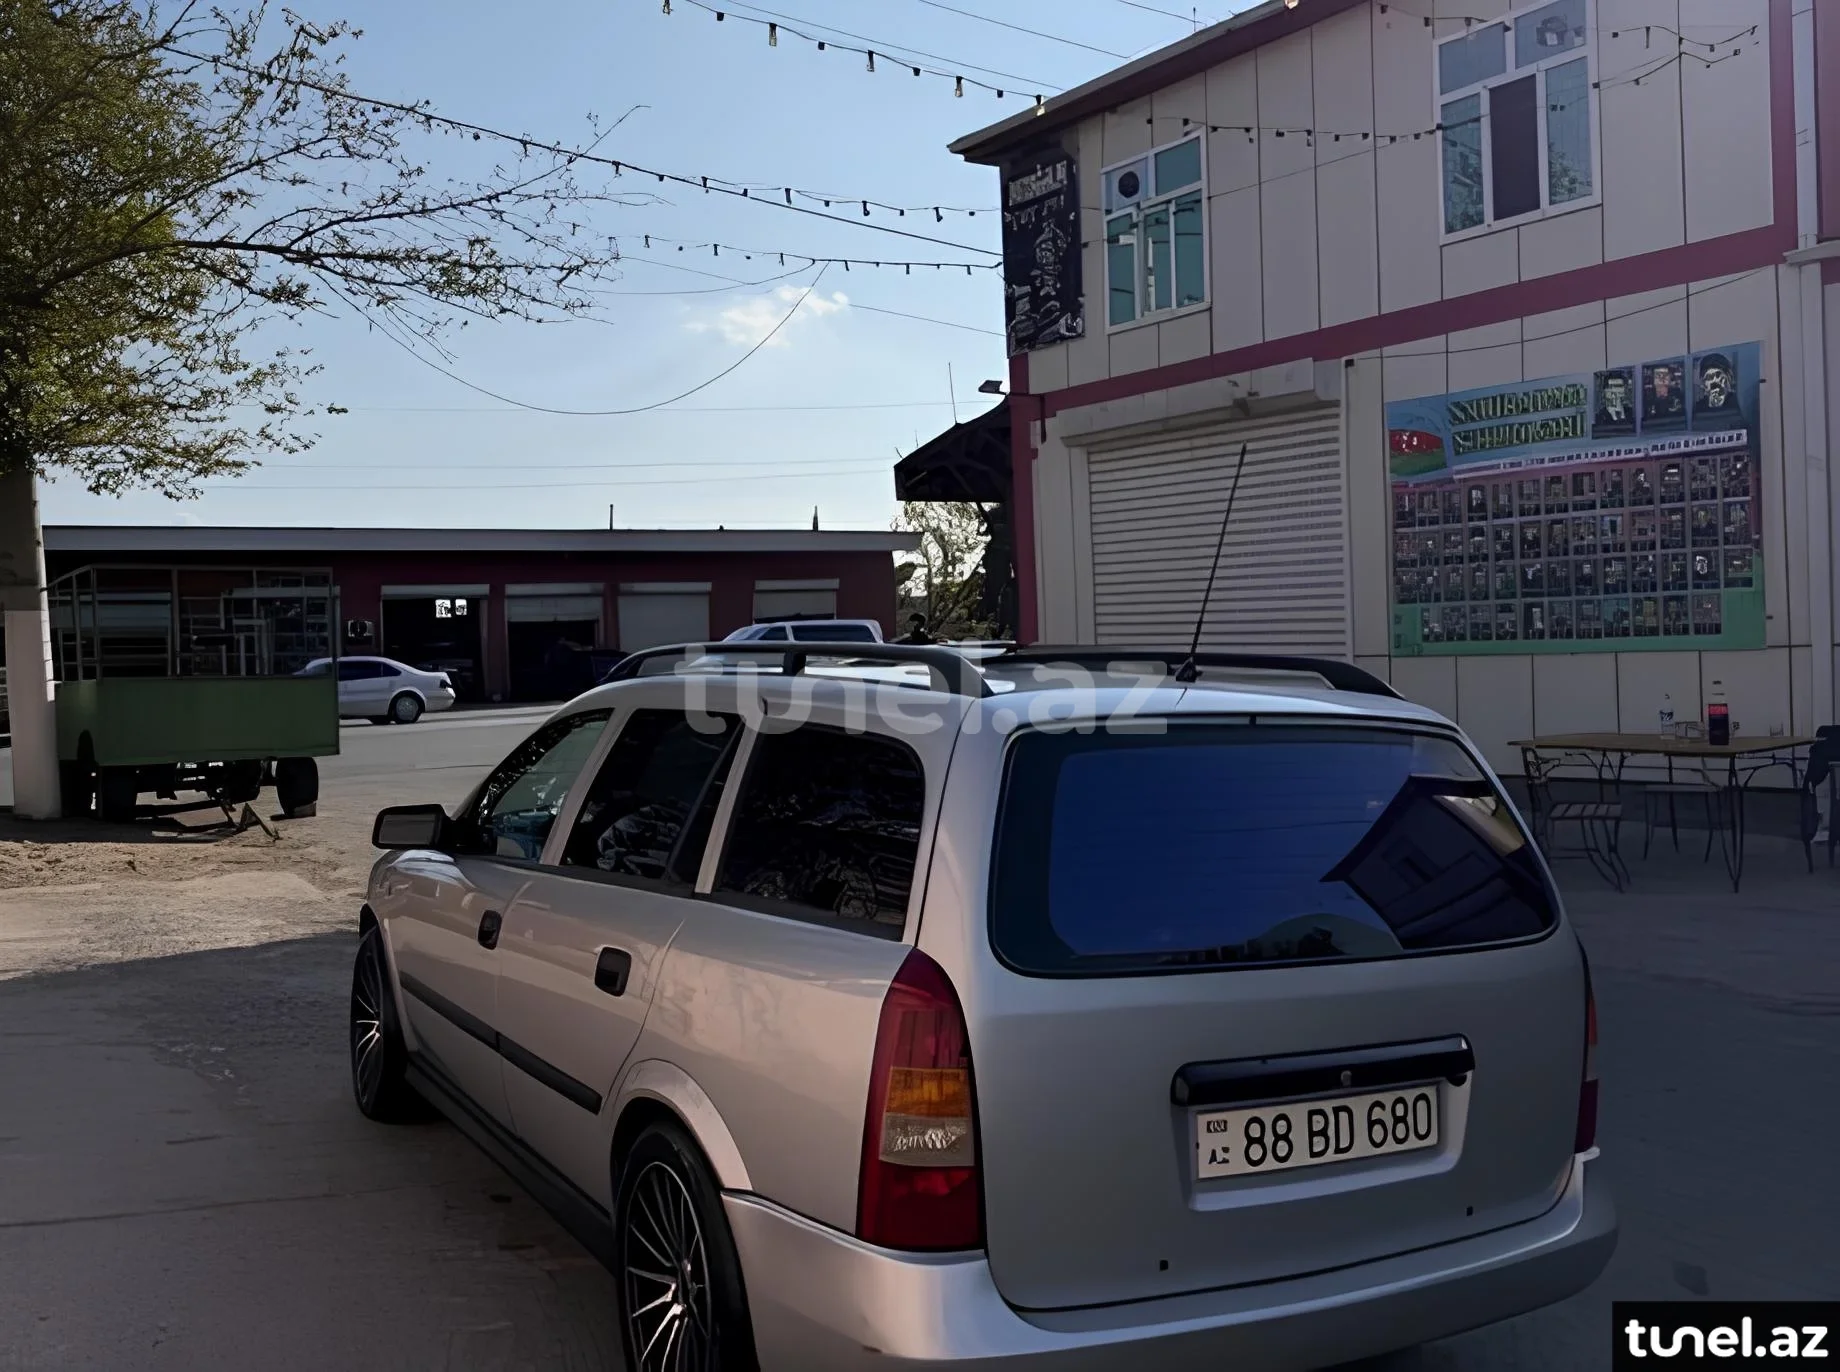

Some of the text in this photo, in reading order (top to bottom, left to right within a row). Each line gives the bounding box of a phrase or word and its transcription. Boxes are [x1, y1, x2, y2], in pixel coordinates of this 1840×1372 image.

[1244, 1092, 1432, 1167] 88 BD 680
